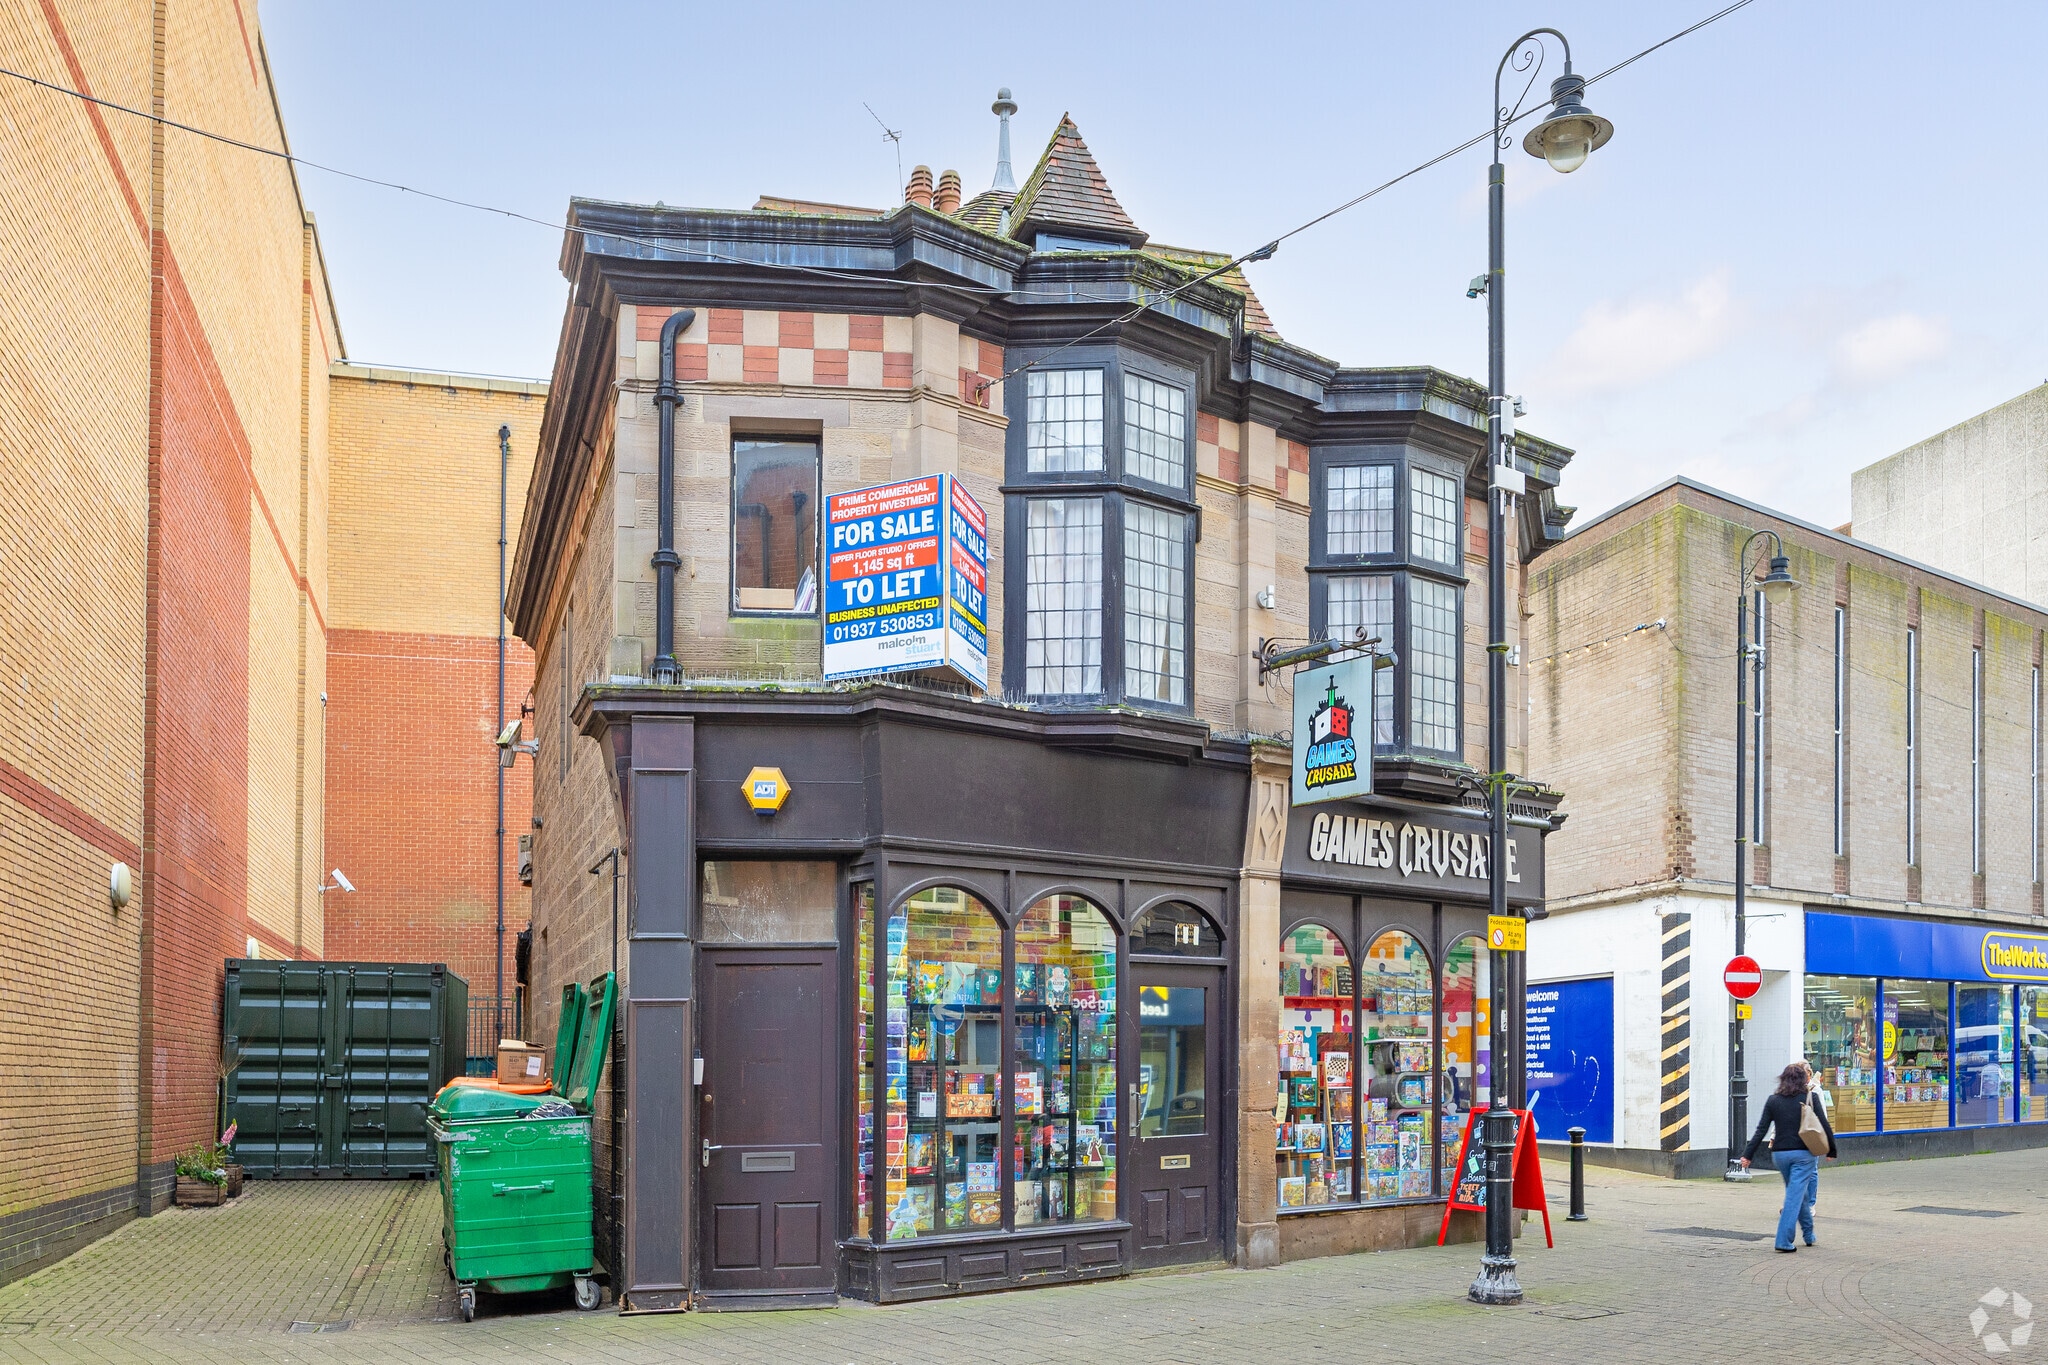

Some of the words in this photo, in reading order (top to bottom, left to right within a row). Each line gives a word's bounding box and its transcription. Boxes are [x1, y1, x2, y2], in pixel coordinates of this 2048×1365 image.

[832, 503, 878, 520] PROPERTY
[880, 492, 937, 511] INVESTMENT
[838, 493, 867, 507] PRIME
[868, 482, 929, 502] COMMERCIAL
[834, 520, 875, 548] FOR
[881, 509, 934, 540] SALE
[952, 510, 967, 544] FOR
[967, 527, 985, 562] SALE
[832, 553, 854, 564] UPPER
[855, 549, 877, 560] FLOOR
[878, 545, 903, 556] STUDIO
[907, 539, 936, 550] OFFICES
[853, 557, 884, 576] 1,145
[887, 557, 902, 571] sq
[905, 552, 915, 566] ft
[842, 578, 874, 606] TO
[881, 569, 925, 600] LET
[955, 571, 967, 603] TO
[968, 583, 982, 617] LET
[829, 606, 876, 623] BUSINESS
[877, 597, 940, 616] UNAFFECTED
[833, 621, 877, 641] 01937
[880, 612, 934, 634] 530853
[878, 635, 926, 650] malcolm
[905, 641, 941, 655] stuart
[1306, 738, 1355, 769] GAMES
[1306, 762, 1356, 787] CRUSADE
[754, 784, 777, 795] ADT
[1310, 812, 1395, 869] GAMES
[1399, 822, 1521, 883] CRUSAE
[1526, 990, 1559, 1002] welcome
[1533, 1071, 1554, 1079] Opticians
